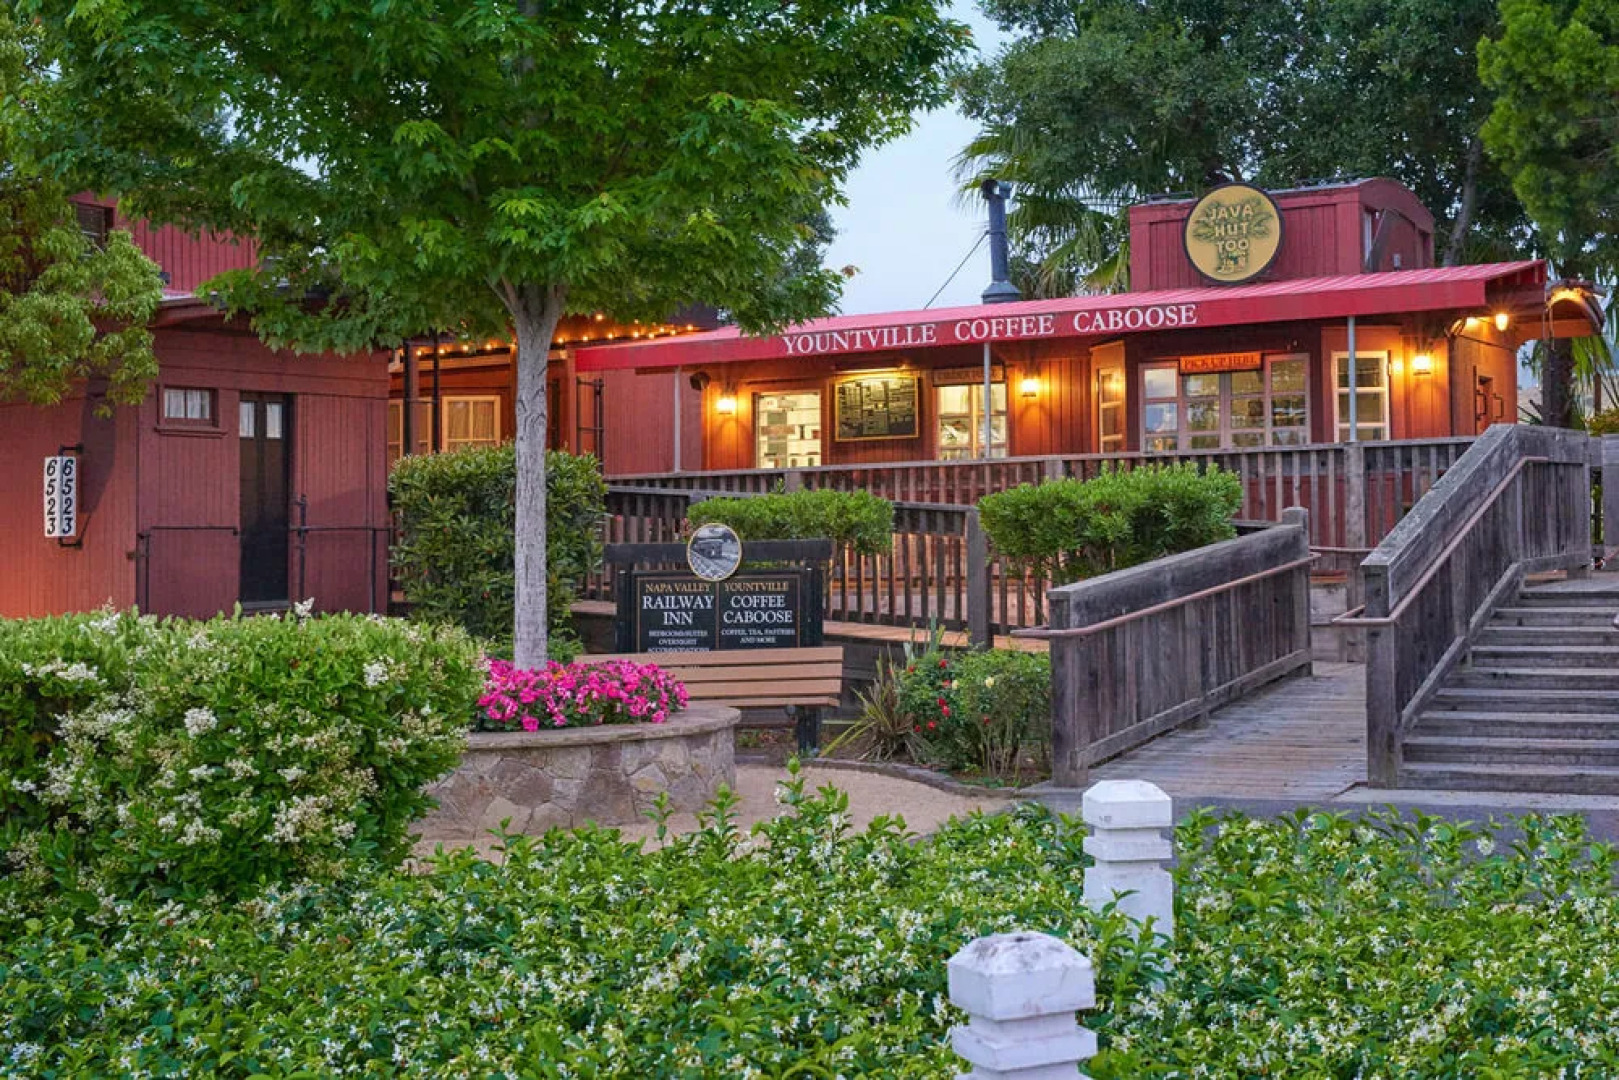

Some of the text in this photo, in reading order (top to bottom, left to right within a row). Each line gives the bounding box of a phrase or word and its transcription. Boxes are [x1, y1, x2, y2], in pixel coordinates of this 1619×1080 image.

[1209, 203, 1254, 220] JAVA
[1214, 221, 1249, 237] HUT
[1216, 239, 1249, 253] TOO
[783, 304, 1197, 355] YOUNTVILLE COFFEE CABOOSE
[46, 459, 57, 535] 6523
[62, 459, 74, 534] 6523
[645, 583, 711, 592] NAPA VALLEY
[724, 582, 789, 592] YOUNTVILLE
[642, 595, 714, 610] RAILWAY
[730, 595, 786, 608] COFFEE
[663, 611, 694, 626] INN
[722, 610, 793, 624] CABOOSE
